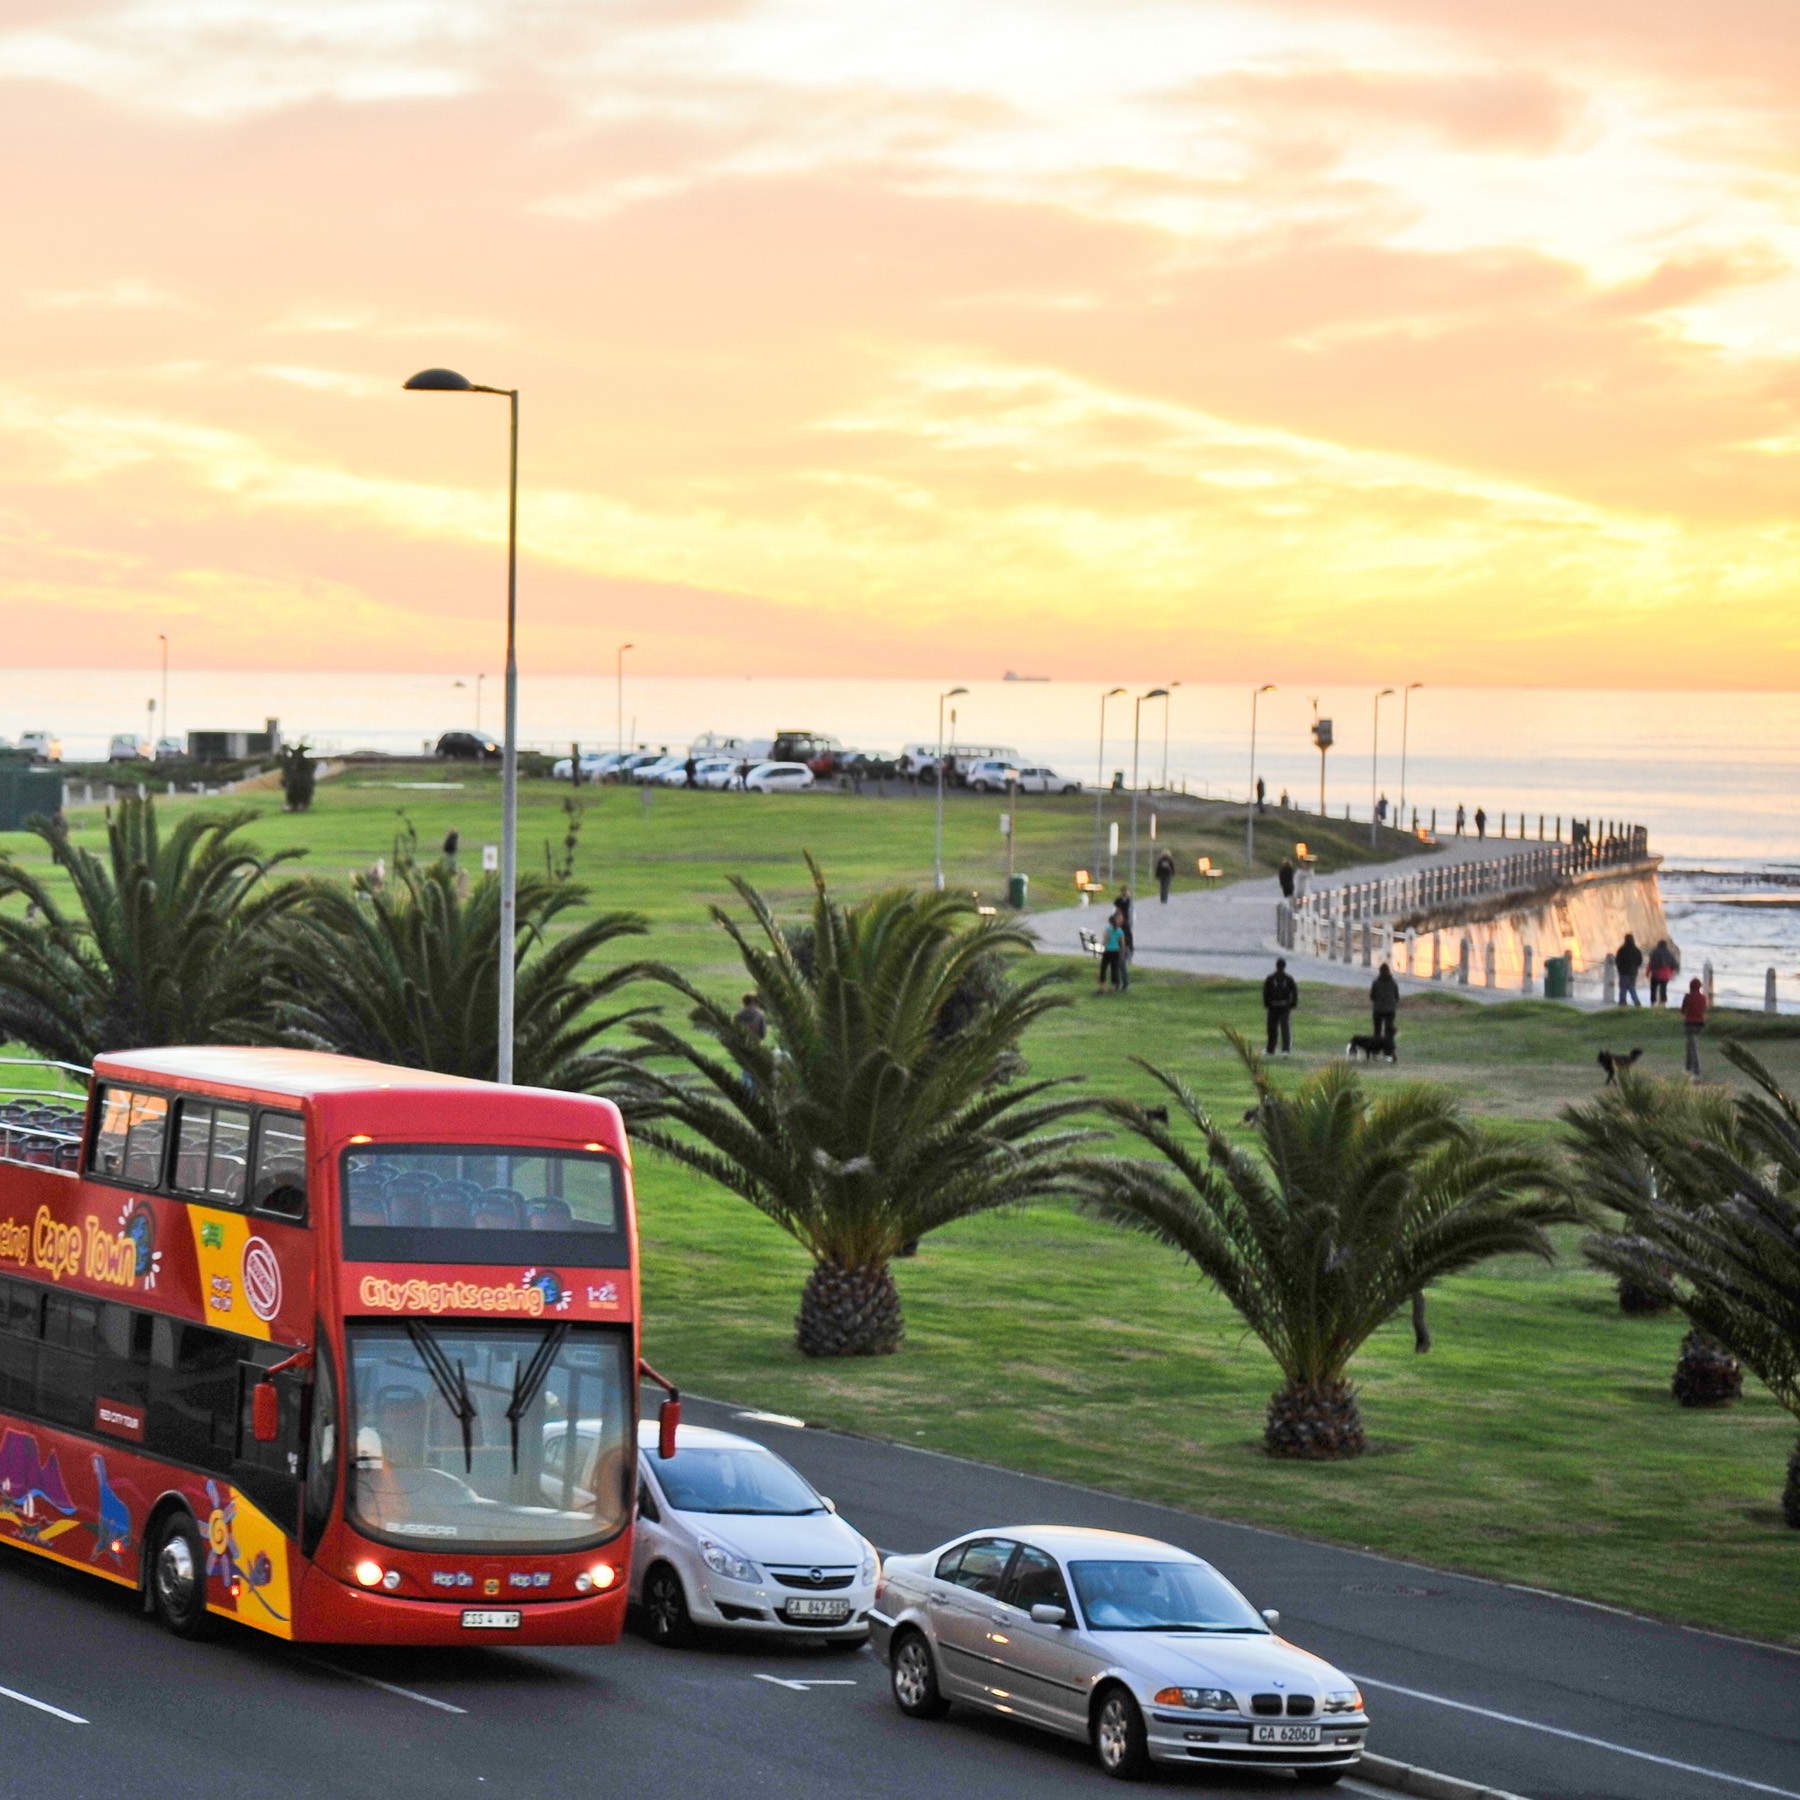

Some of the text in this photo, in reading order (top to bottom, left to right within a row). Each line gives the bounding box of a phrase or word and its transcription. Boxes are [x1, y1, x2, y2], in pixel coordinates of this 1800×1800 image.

[33, 1205, 82, 1281] Cape
[85, 1215, 137, 1287] Town
[360, 1276, 545, 1316] CitySightseeing
[433, 1570, 473, 1587] Hop On
[509, 1571, 551, 1588] Hop Off
[1259, 1727, 1316, 1741] CA 62060
